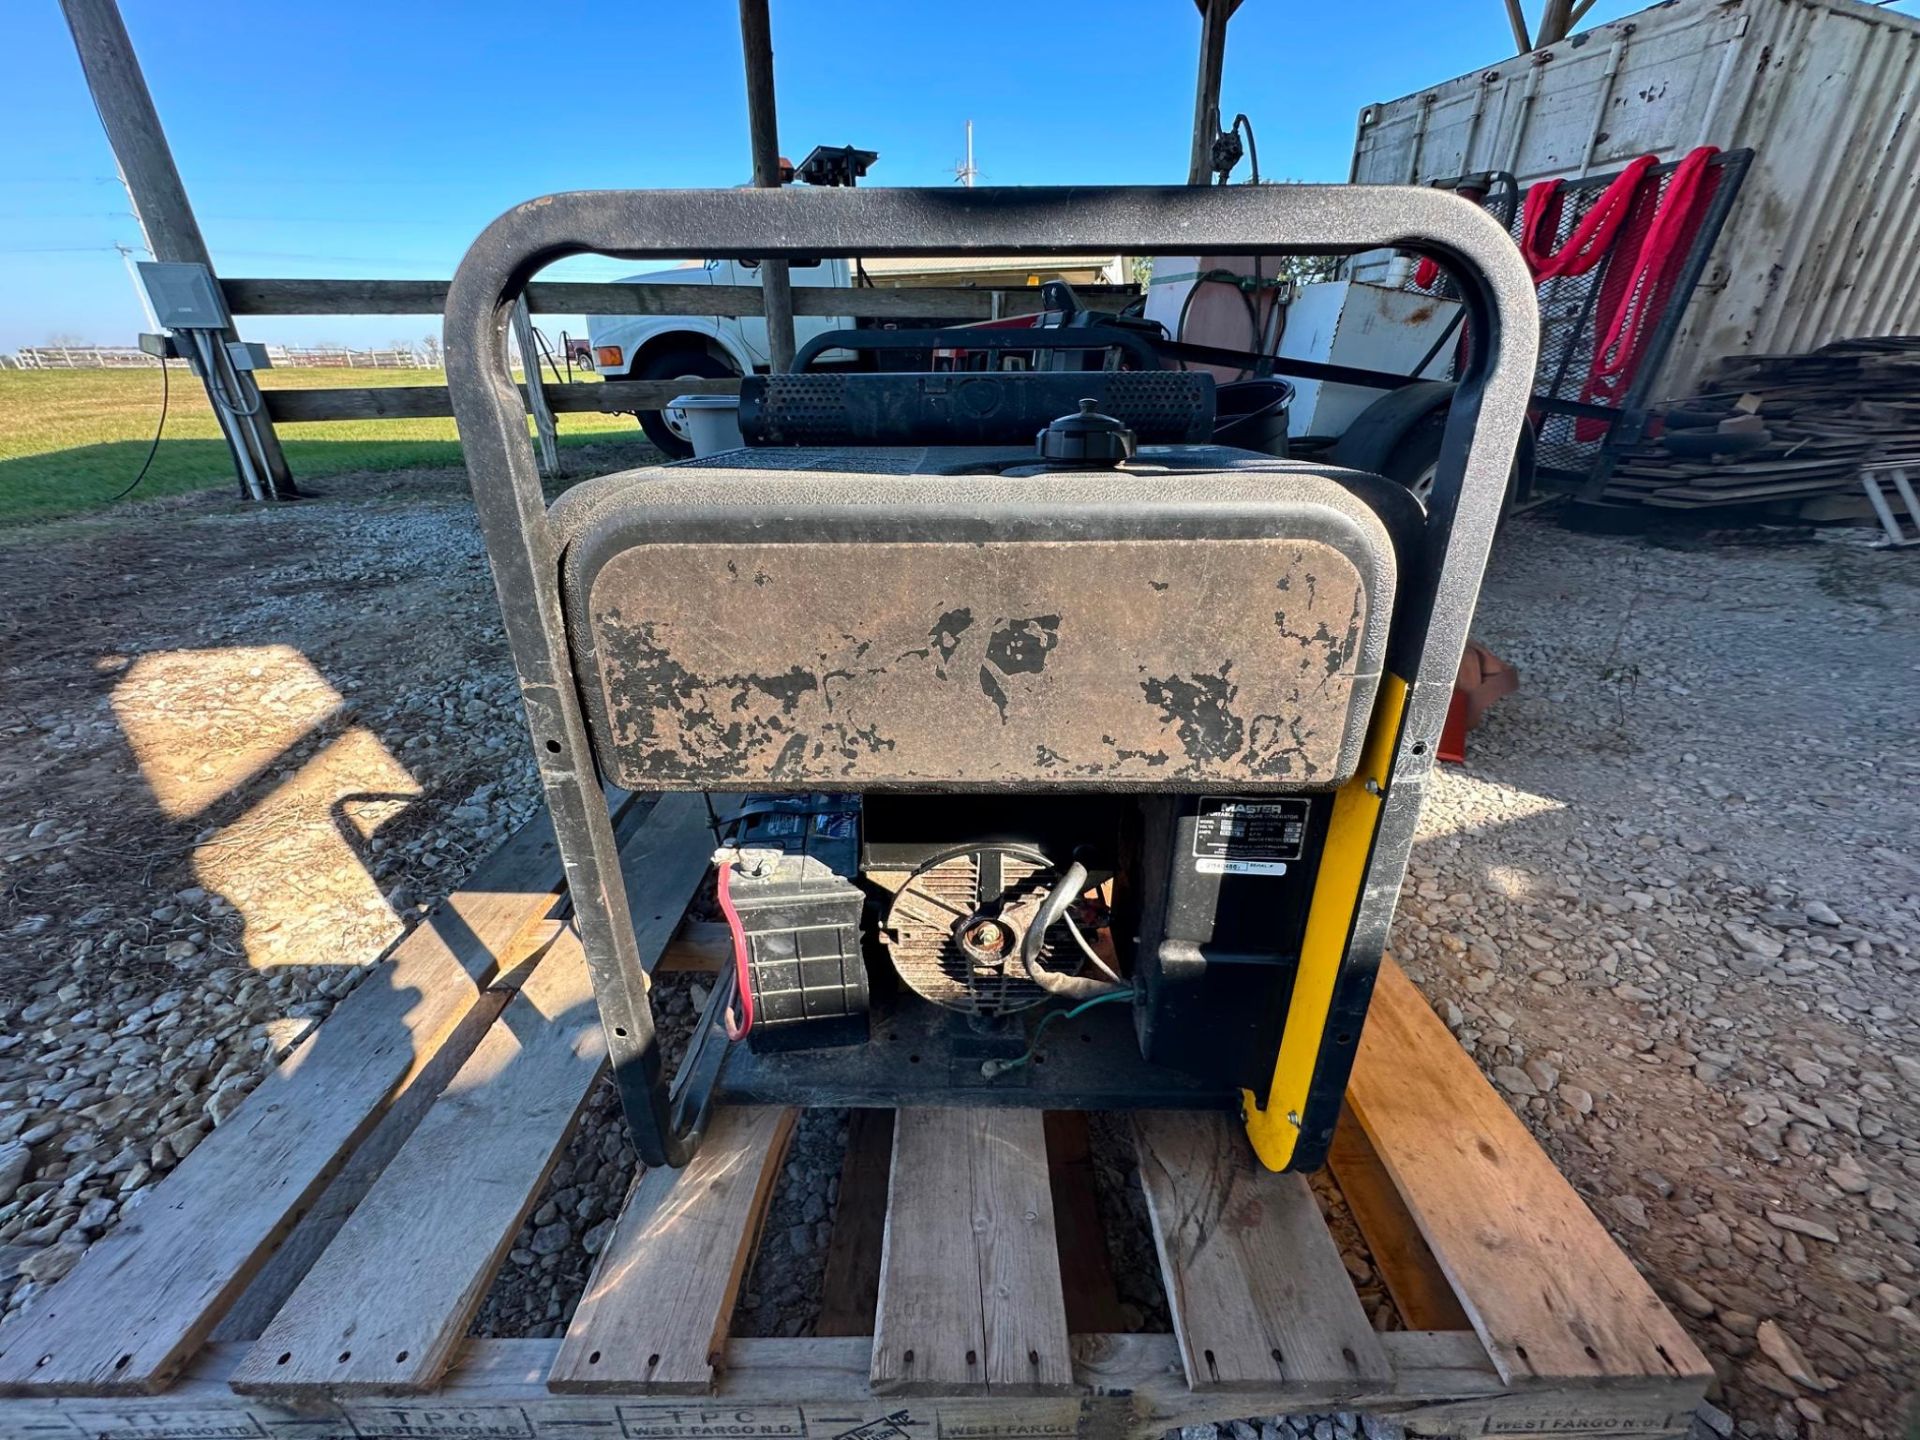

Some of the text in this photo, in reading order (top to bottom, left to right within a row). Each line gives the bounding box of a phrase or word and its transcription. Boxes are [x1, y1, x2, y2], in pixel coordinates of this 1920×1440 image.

[916, 376, 1040, 420] HOT
[1221, 803, 1281, 814] MASTER
[949, 1423, 1070, 1435] WEST FARGO
[1496, 1418, 1546, 1430] WEST
[1552, 1417, 1617, 1429] FARGO
[150, 1427, 214, 1437] FARGO
[362, 1425, 412, 1435] WEST
[416, 1425, 482, 1435] FARGO
[632, 1426, 684, 1436] WEST
[692, 1425, 754, 1435] FARGO
